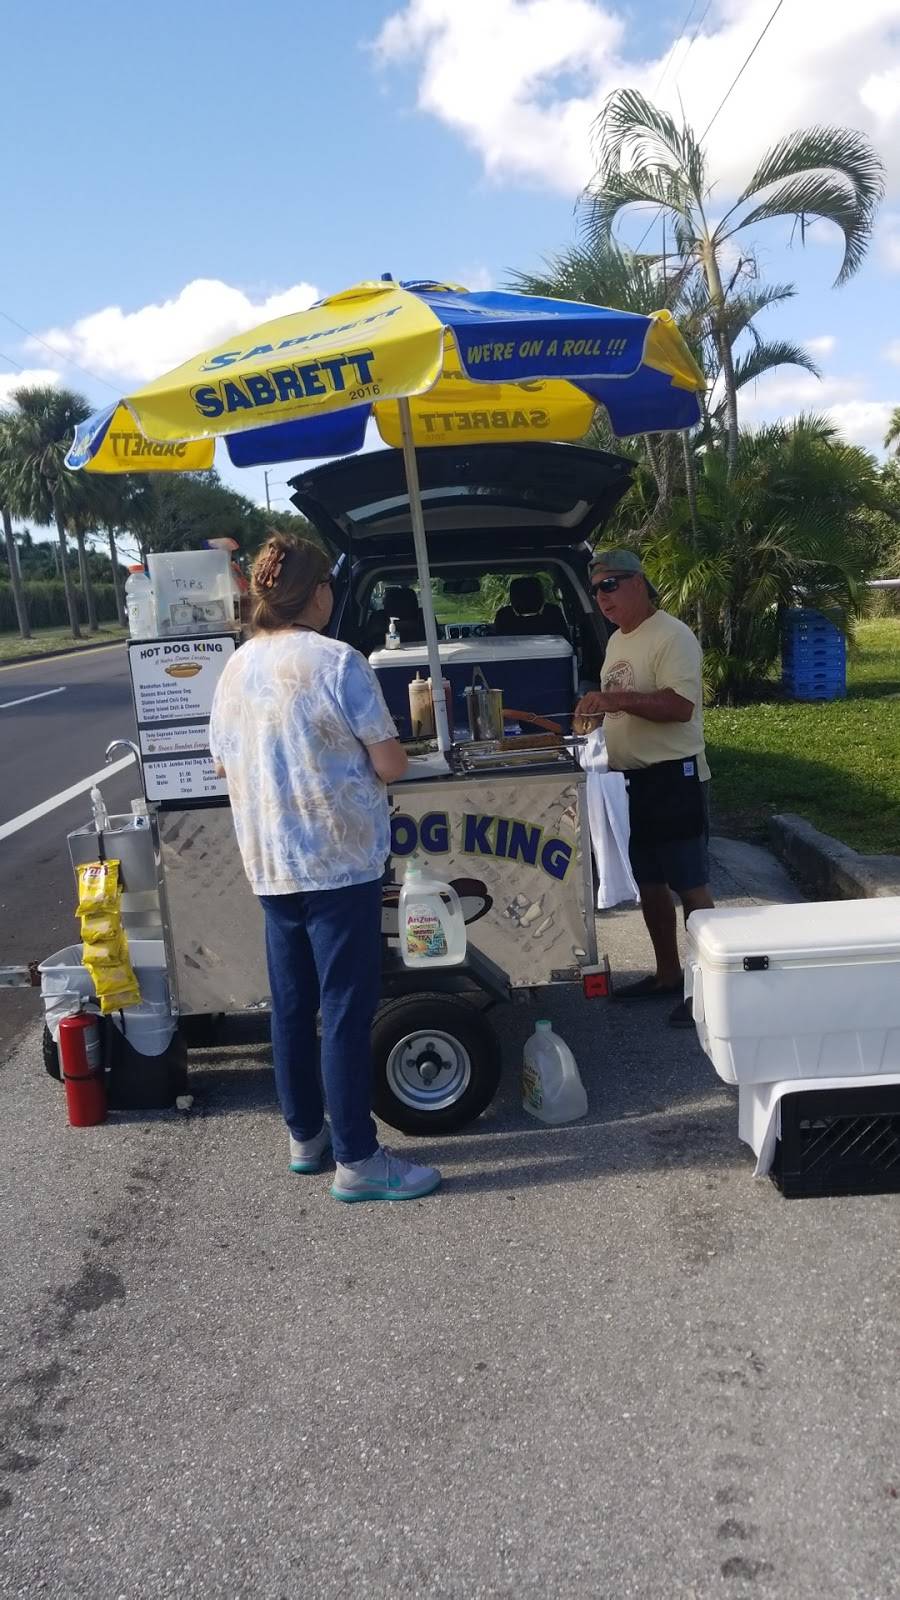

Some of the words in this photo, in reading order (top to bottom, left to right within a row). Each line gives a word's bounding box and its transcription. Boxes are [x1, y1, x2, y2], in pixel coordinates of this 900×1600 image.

[467, 342, 516, 365] WE'RE
[519, 339, 545, 358] ON
[546, 339, 559, 357] A
[562, 338, 603, 358] ROLL
[605, 338, 628, 356] !!!
[189, 347, 376, 418] SABRETT
[349, 385, 381, 401] 2016
[140, 647, 160, 659] HOT
[164, 644, 190, 654] DOG
[194, 643, 223, 652] KING
[390, 810, 450, 859] OG
[462, 812, 577, 885] KING
